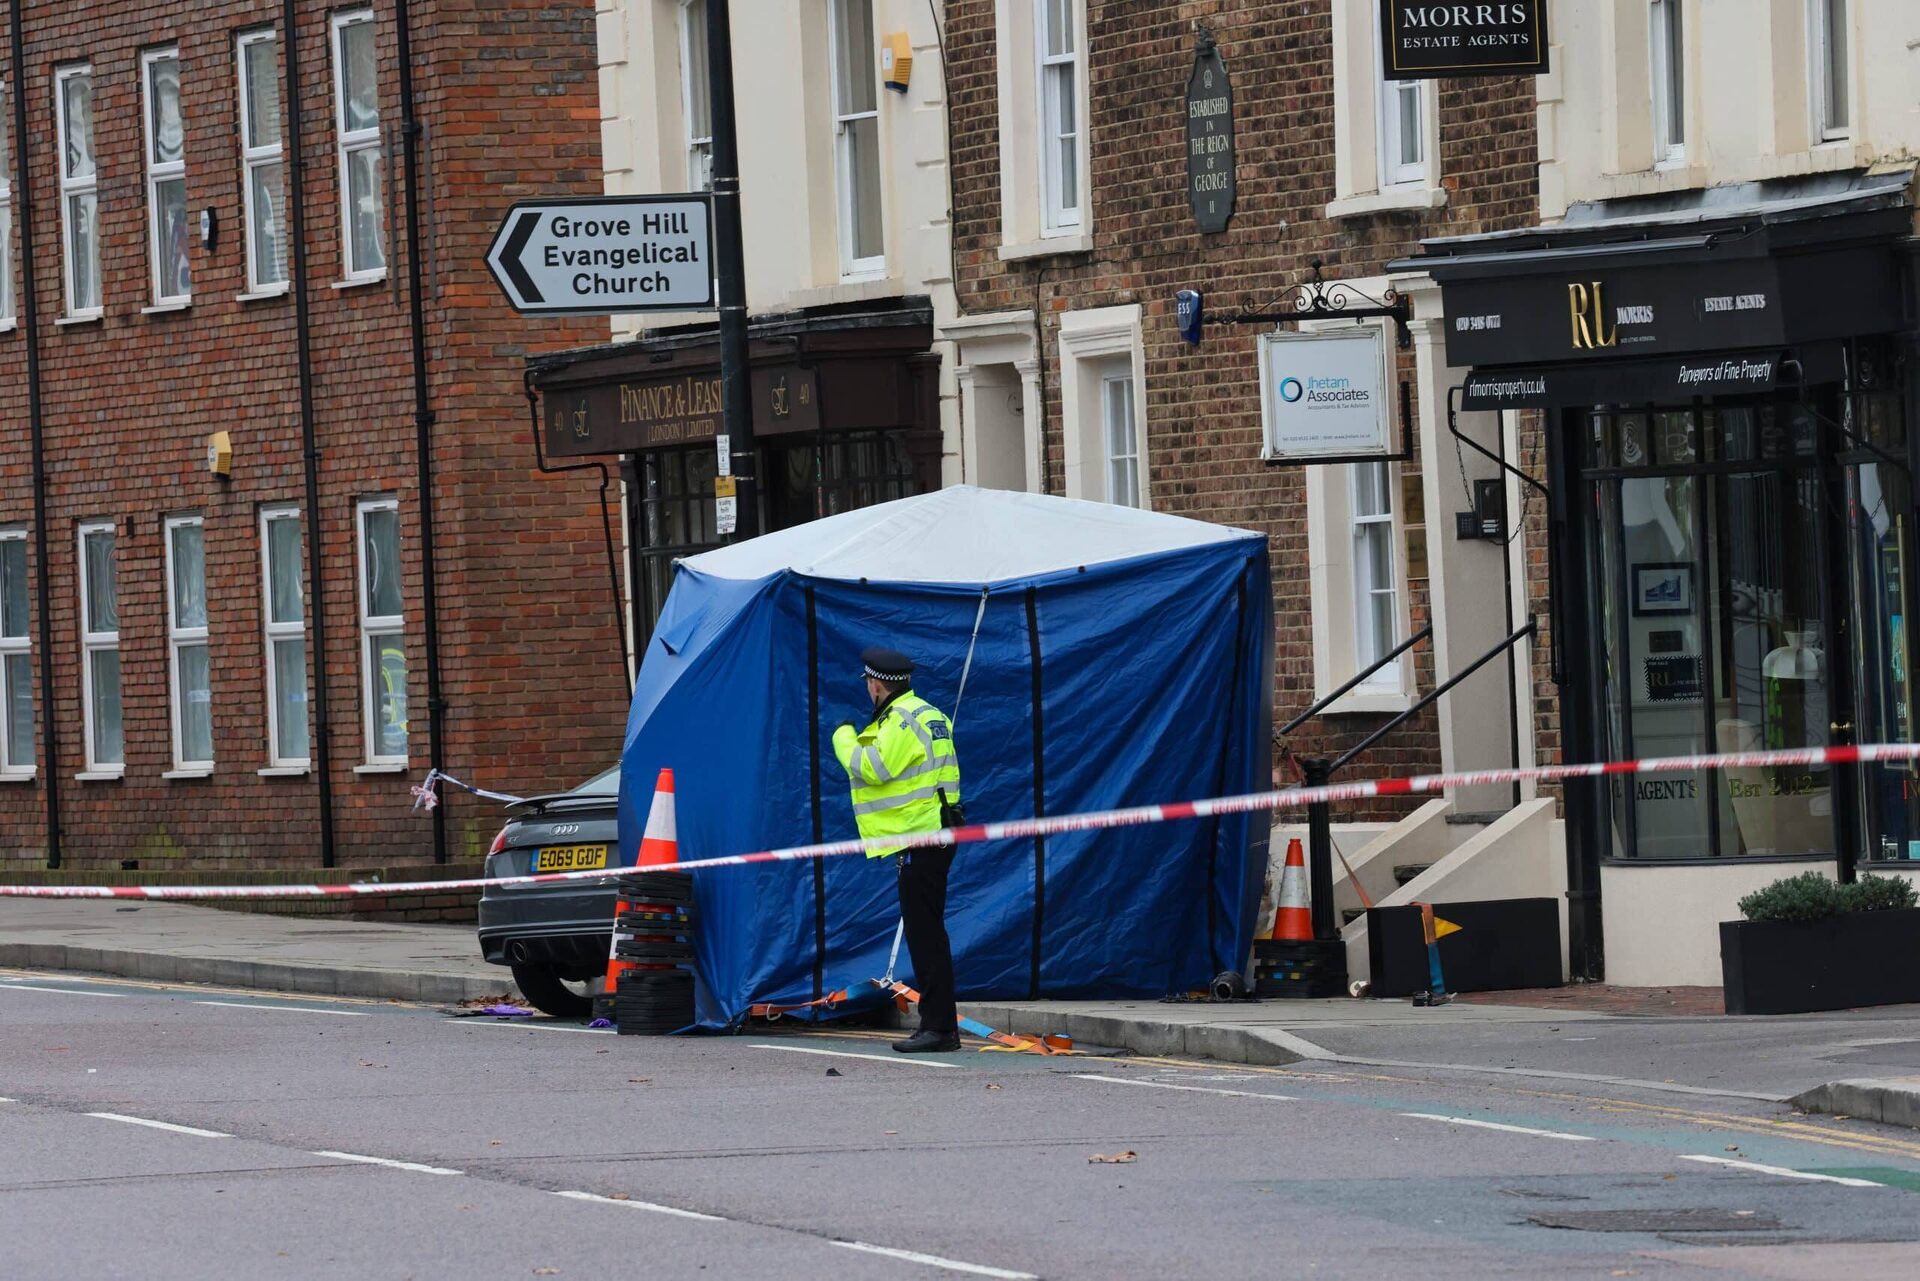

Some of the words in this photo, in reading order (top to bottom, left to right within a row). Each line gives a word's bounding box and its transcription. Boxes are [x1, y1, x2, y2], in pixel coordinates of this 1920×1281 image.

[1403, 3, 1526, 27] MORRIS
[1403, 35, 1461, 49] ESTATE
[1468, 33, 1529, 46] AGENTS
[1189, 97, 1228, 119] ESTABLISHED
[1206, 120, 1214, 132] IN
[1191, 138, 1205, 155] THE
[1207, 134, 1230, 154] REIGN
[1206, 156, 1215, 170] OF
[1195, 171, 1228, 192] GEORGE
[550, 216, 631, 238] Grove
[643, 212, 689, 235] Hill
[544, 241, 699, 269] Evangelical
[572, 271, 671, 295] Church
[1704, 296, 1733, 312] ESTATE
[1735, 294, 1766, 310] AGENTS
[1567, 281, 1617, 349] RL
[1616, 305, 1654, 325] MORRIS
[1306, 376, 1349, 390] Jhetam
[1677, 365, 1715, 386] Purveyors
[1714, 361, 1725, 381] of
[1723, 361, 1740, 380] Fine
[1740, 360, 1772, 383] Property
[1307, 389, 1369, 402] Associates
[1469, 375, 1546, 400] rlmorrisproperty.co.uk
[619, 384, 673, 423] FINANCE
[675, 384, 686, 417] &
[648, 420, 684, 443] (LONDON)
[686, 418, 715, 438] LIMITED
[1637, 778, 1697, 801] AGENTS
[540, 849, 573, 868] EO69
[576, 847, 604, 866] GDF
